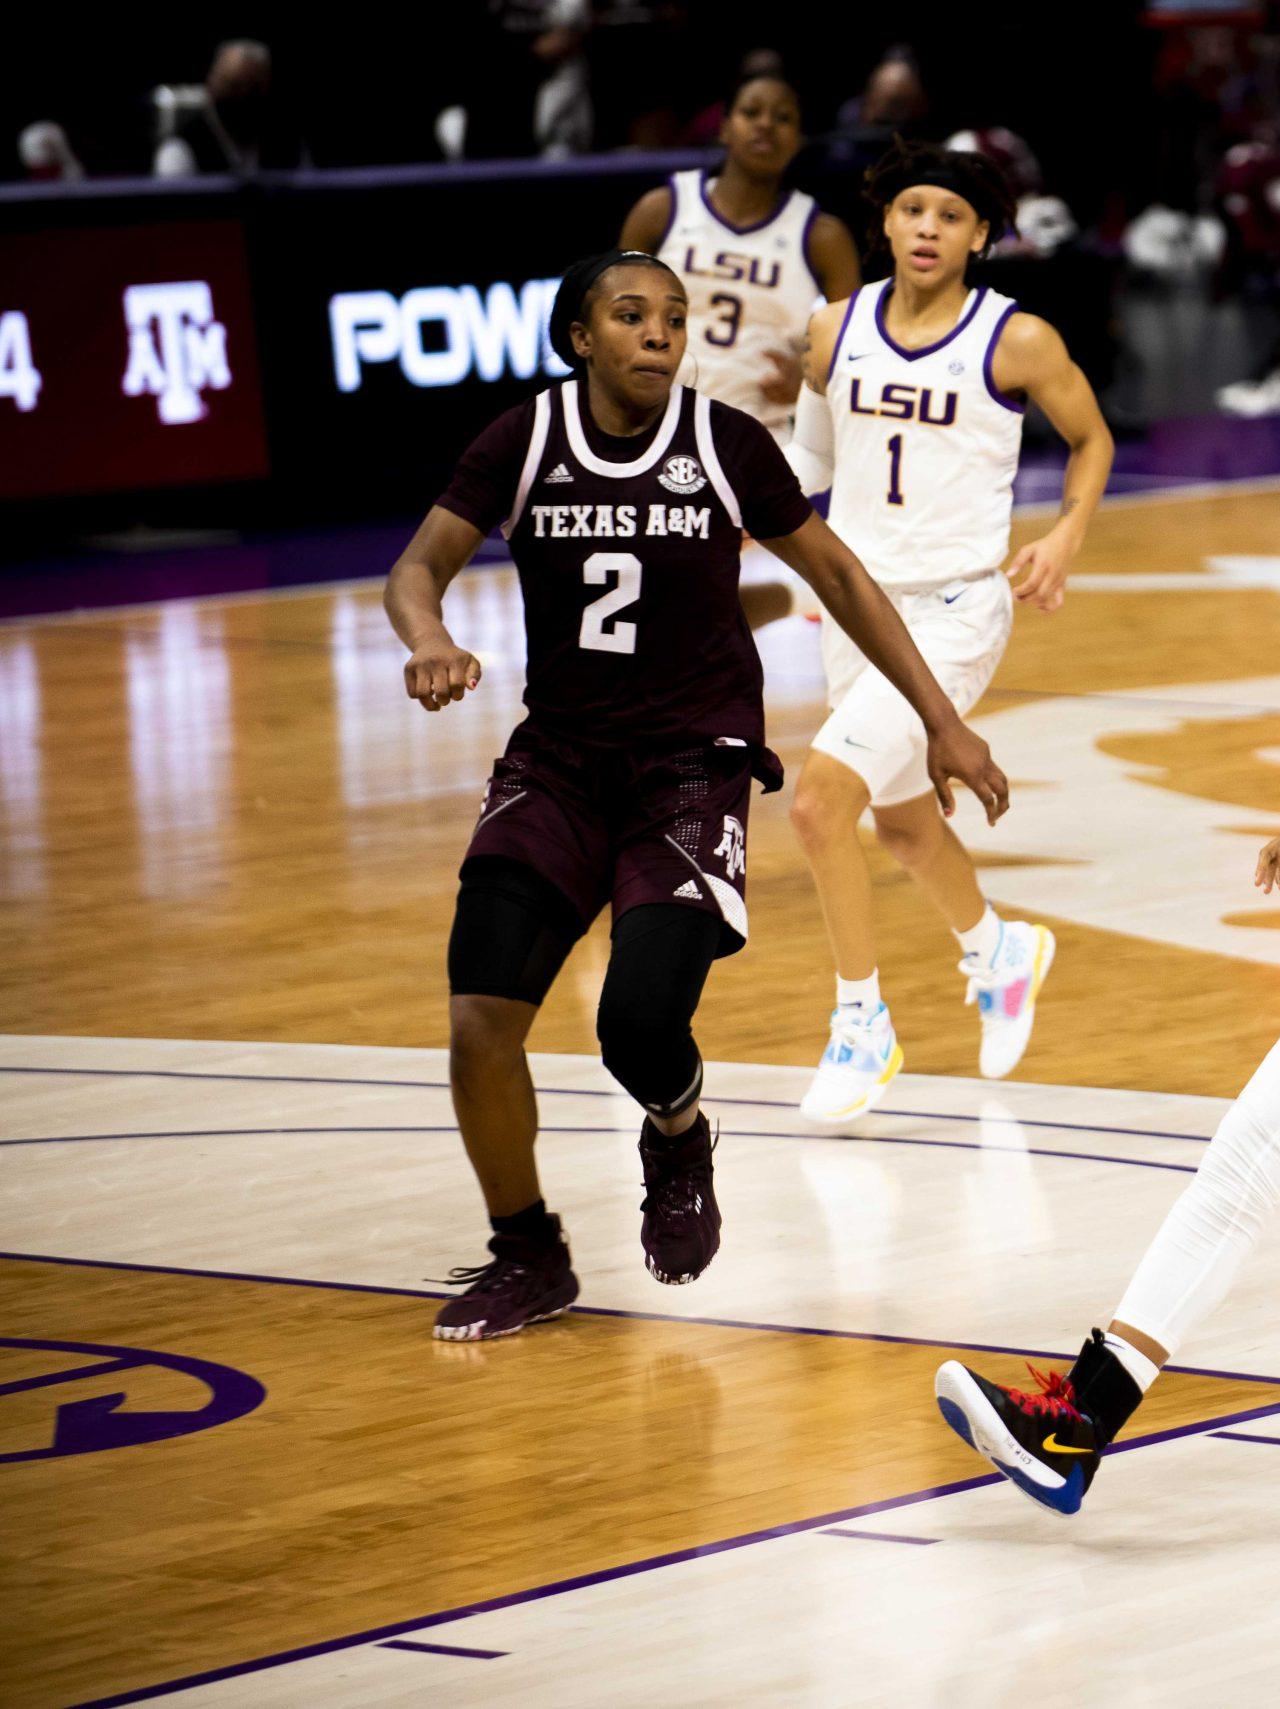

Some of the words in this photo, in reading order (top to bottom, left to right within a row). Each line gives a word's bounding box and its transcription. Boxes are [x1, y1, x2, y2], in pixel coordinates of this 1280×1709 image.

[684, 244, 781, 288] LSU
[704, 291, 744, 349] 3
[850, 376, 959, 428] LSU
[665, 456, 699, 486] SEC
[886, 432, 905, 507] 1
[531, 504, 638, 538] TEXAS
[645, 504, 712, 540] A&M
[578, 552, 643, 655] 2
